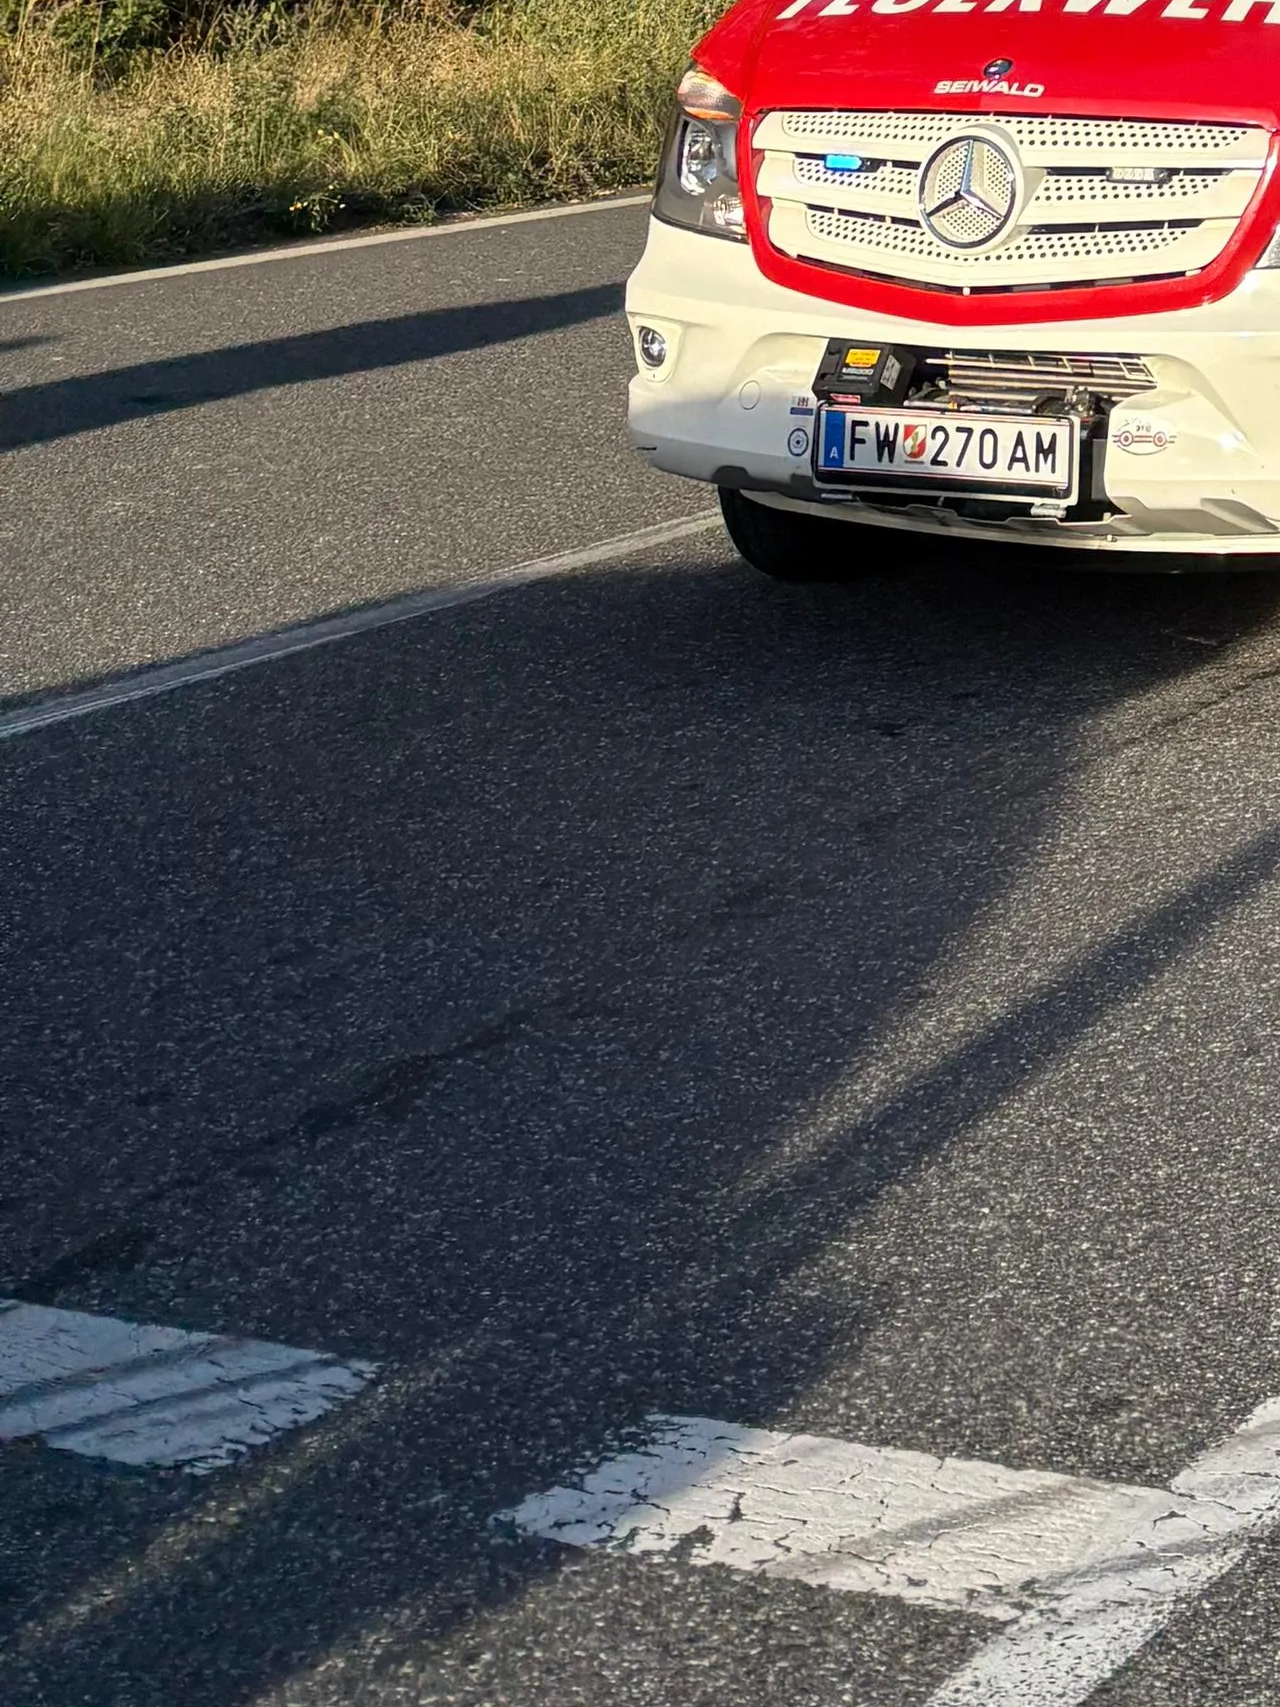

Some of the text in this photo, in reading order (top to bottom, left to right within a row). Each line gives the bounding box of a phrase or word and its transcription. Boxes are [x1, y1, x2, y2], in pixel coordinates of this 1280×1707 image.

[933, 79, 1045, 98] SEIWALD
[849, 419, 900, 464] FW
[829, 446, 839, 459] A
